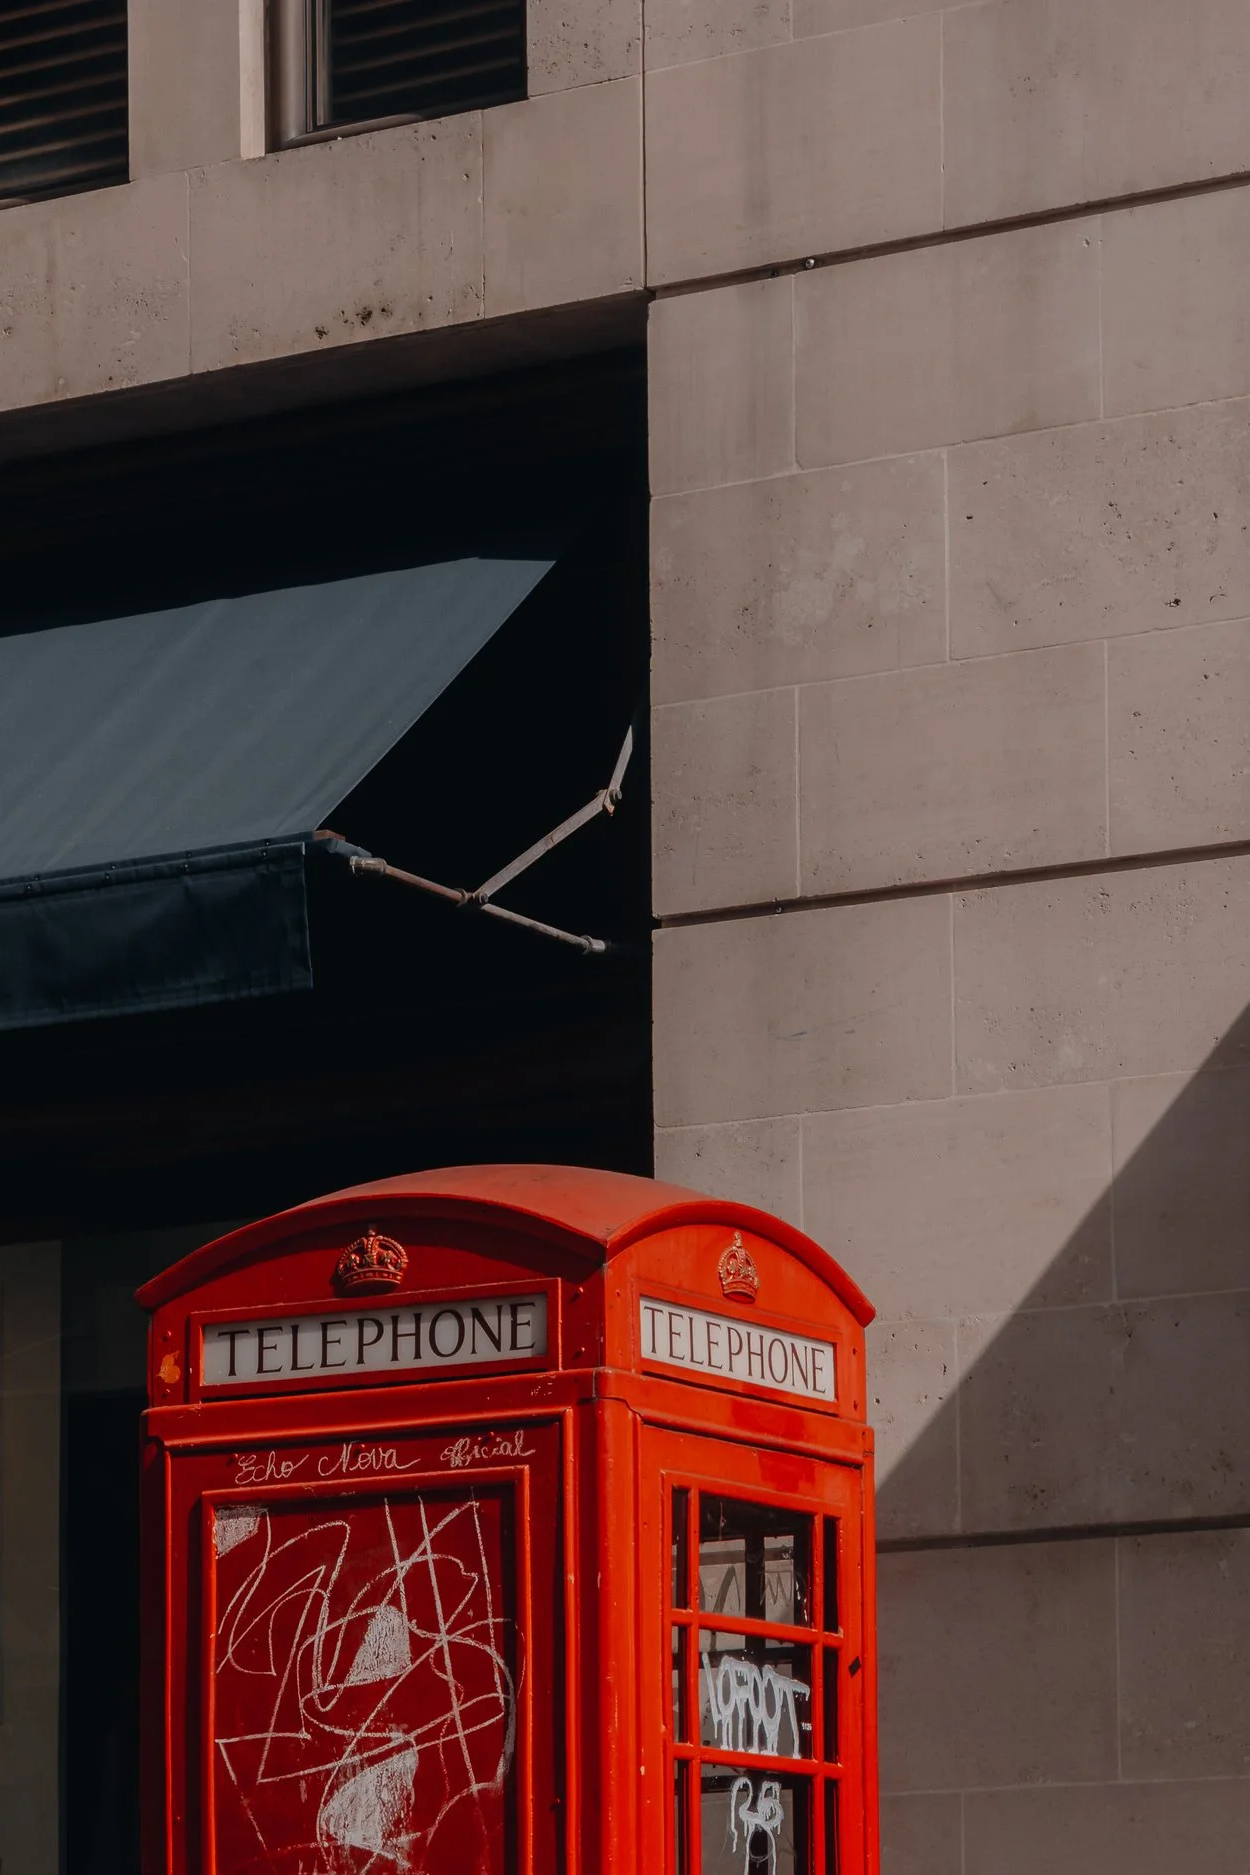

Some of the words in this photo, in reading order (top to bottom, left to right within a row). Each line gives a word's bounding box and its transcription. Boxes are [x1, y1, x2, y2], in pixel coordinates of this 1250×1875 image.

[218, 1302, 536, 1376] TELEPHONE
[644, 1306, 825, 1393] TELEPHONE
[236, 1451, 309, 1485] Echo
[318, 1442, 421, 1476] Nova
